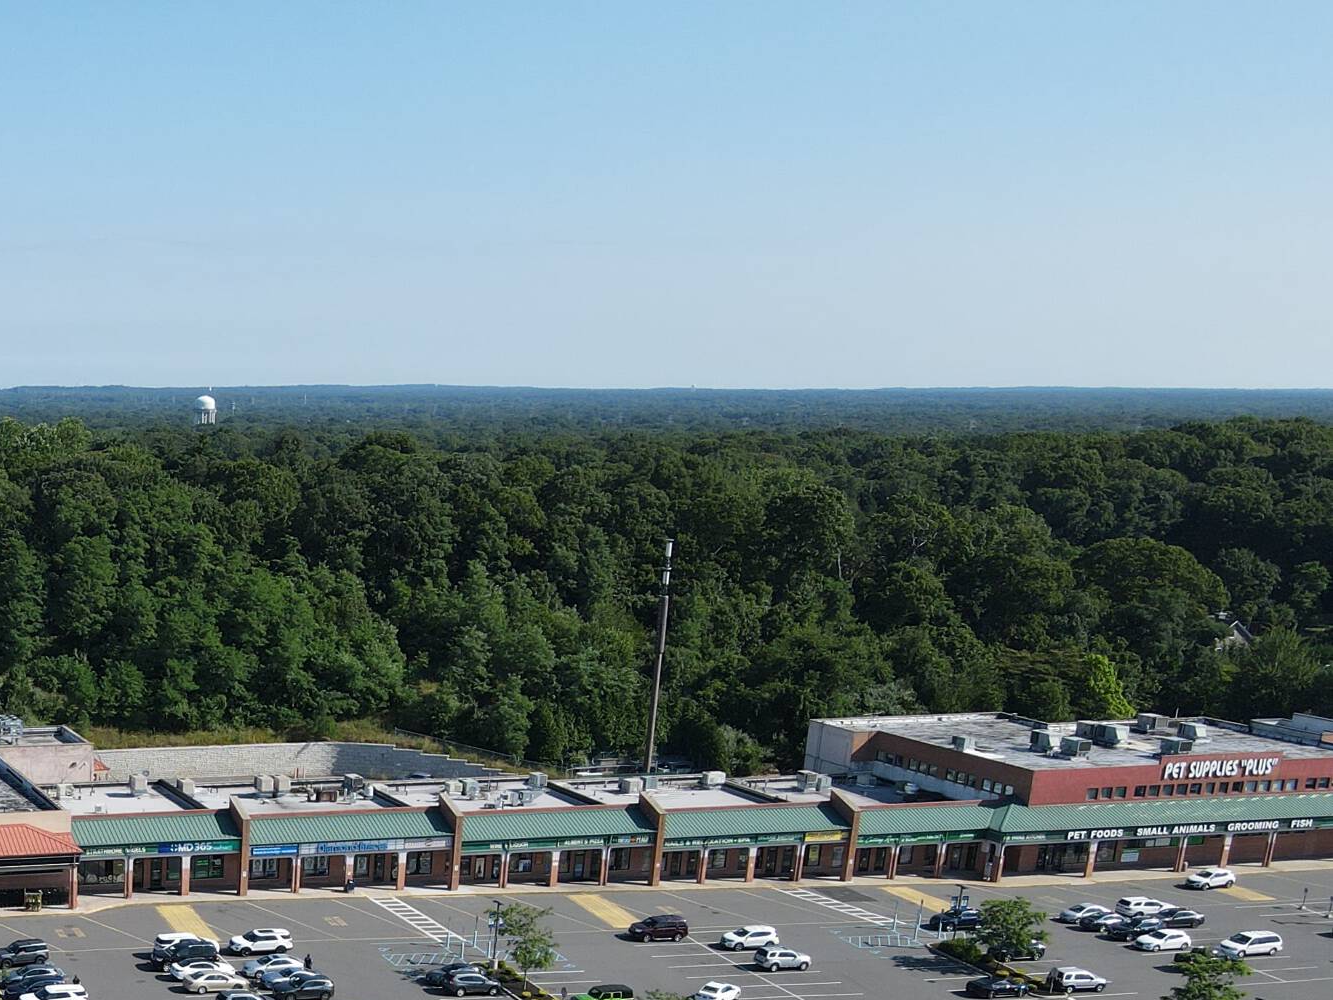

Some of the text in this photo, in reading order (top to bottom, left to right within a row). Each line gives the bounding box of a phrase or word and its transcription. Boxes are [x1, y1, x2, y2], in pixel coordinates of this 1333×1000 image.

[1164, 757, 1279, 779] PET SUPPLIES "PLUS"
[1227, 820, 1279, 832] GROOMING
[1290, 819, 1313, 828] FISH
[1067, 829, 1124, 841] PET FOODS
[1136, 824, 1216, 836] SMALL ANIMALS
